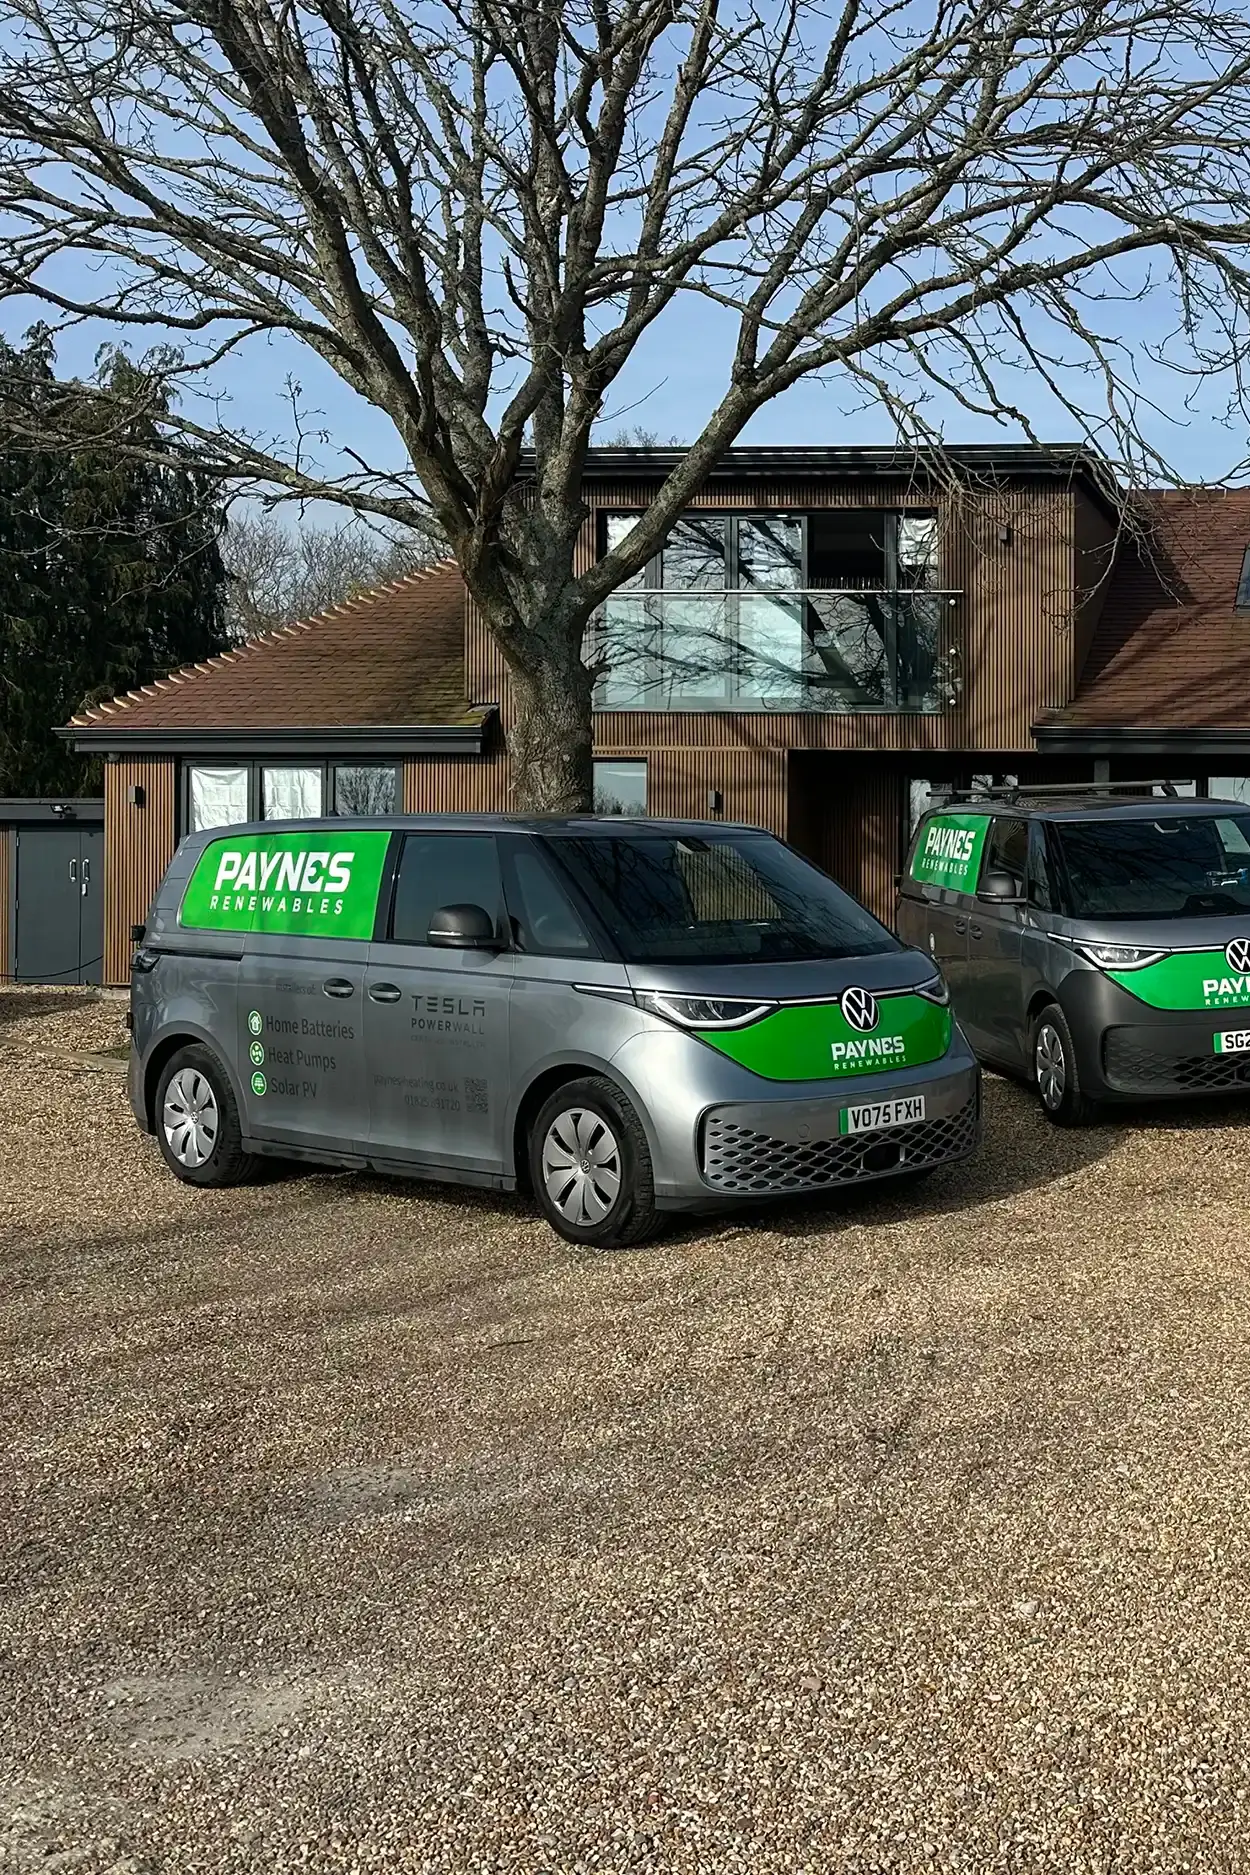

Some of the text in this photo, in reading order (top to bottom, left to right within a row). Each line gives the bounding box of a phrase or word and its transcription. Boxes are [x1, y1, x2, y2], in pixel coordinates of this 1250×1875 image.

[925, 826, 976, 861] PAYNES
[213, 851, 355, 893] PAYNES
[922, 857, 968, 876] RENEWABLES
[210, 895, 344, 915] RENEWABLES
[411, 995, 485, 1017] TESLA
[266, 1015, 355, 1040] Home Batteries
[411, 1018, 485, 1035] POWERWALL
[268, 1047, 336, 1072] Heat Pumps
[831, 1036, 905, 1061] PAYNES
[834, 1055, 907, 1071] RENEWABLES
[270, 1077, 317, 1098] Solar PV
[851, 1098, 922, 1129] VO75 FXH
